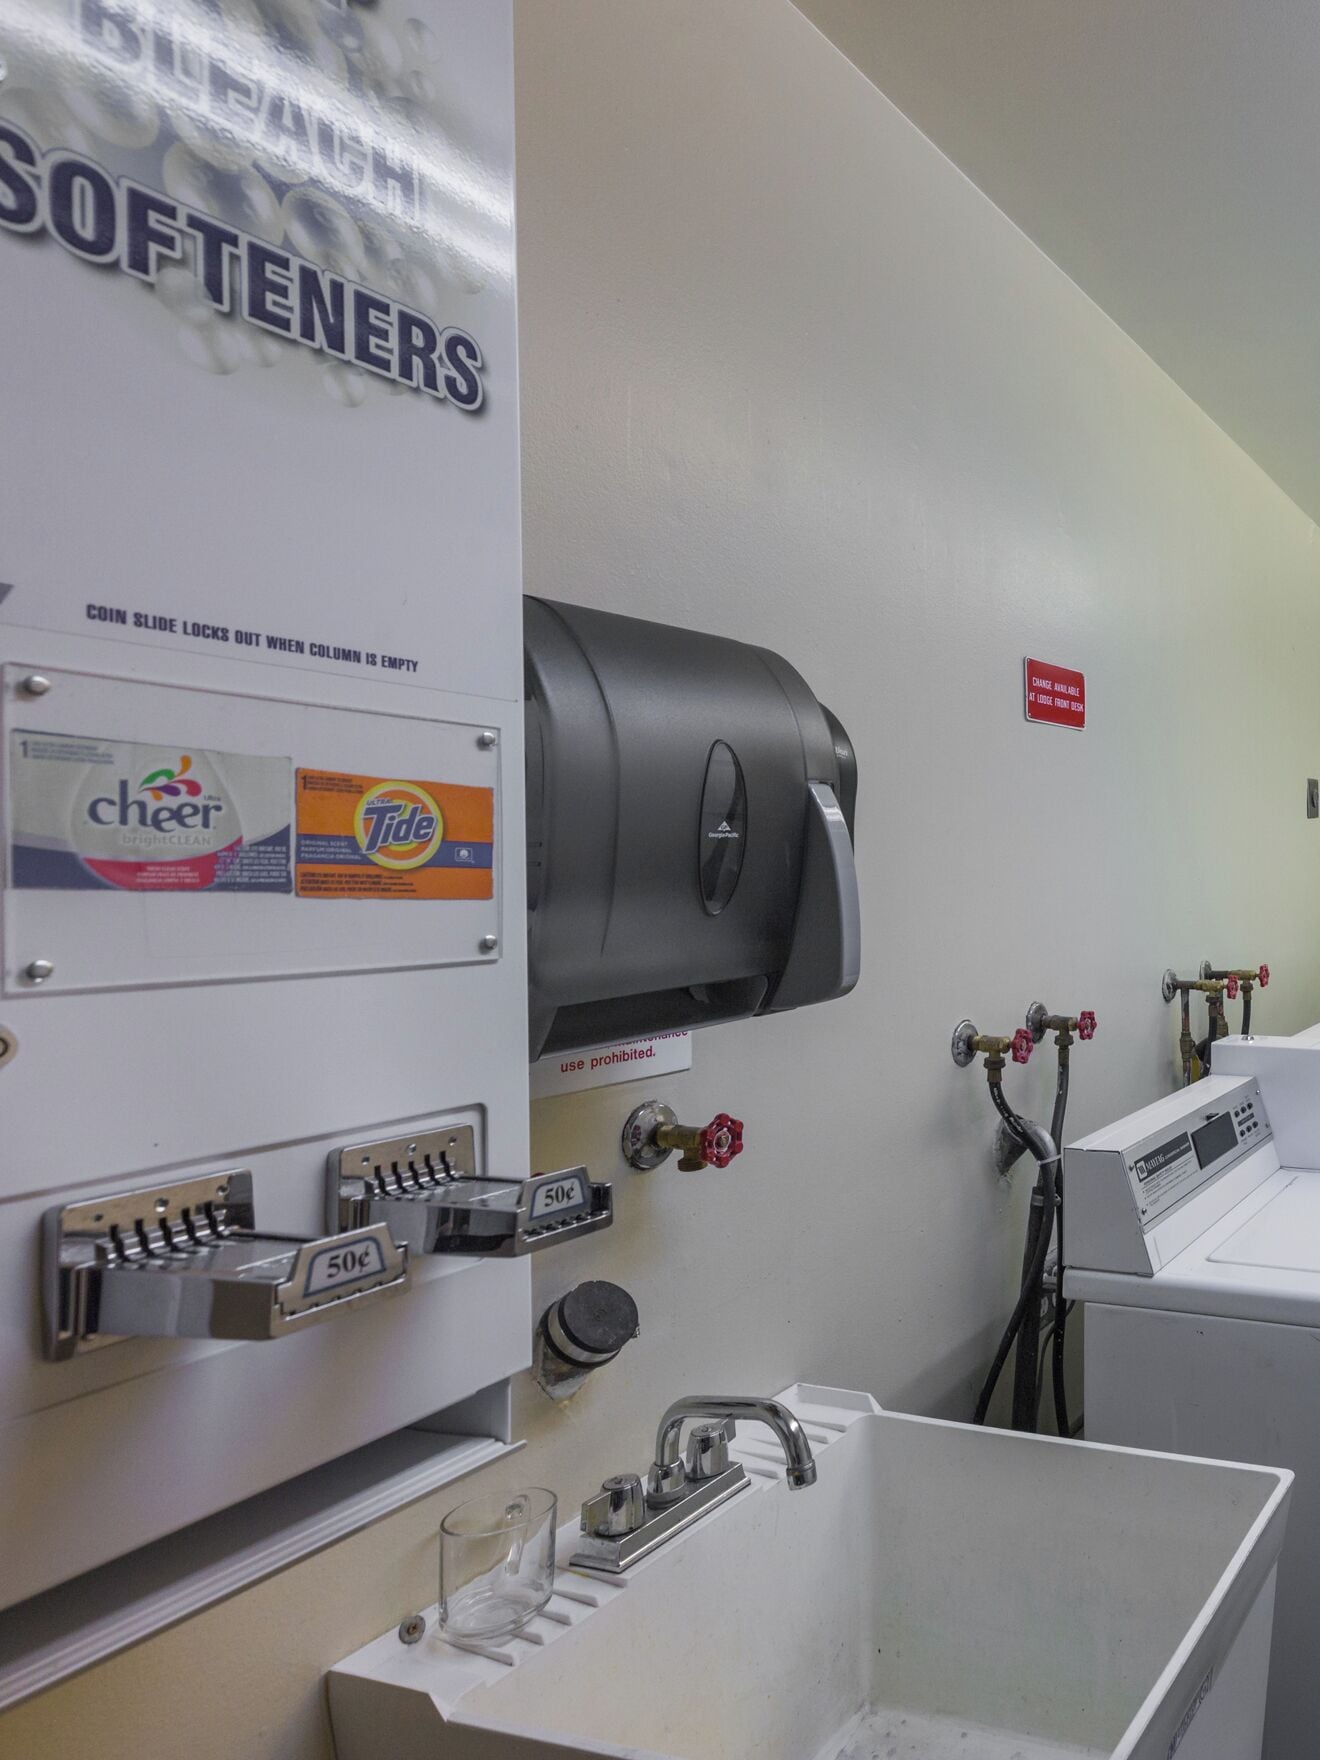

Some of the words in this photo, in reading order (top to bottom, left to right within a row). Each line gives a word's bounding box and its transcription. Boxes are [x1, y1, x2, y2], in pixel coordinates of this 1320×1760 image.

[86, 603, 127, 625] COIN
[133, 611, 178, 633] SLIDE
[182, 620, 230, 642] LOCKS
[234, 629, 262, 647] OUT
[265, 635, 305, 654] WHEN
[309, 642, 362, 663] COLUMN
[365, 652, 378, 666] IS
[381, 655, 419, 673] EMPTY
[1032, 676, 1052, 690] CHANGE
[1054, 682, 1080, 697] AVAILABLE
[1029, 692, 1035, 701] AT
[1037, 694, 1053, 706] LODGE
[1054, 697, 1070, 709] FRONT
[1071, 701, 1084, 712] DESK
[87, 778, 223, 833] cheer
[122, 834, 211, 847] brightCLEAN
[363, 803, 437, 854] Tide
[560, 1059, 585, 1073] use
[590, 1045, 656, 1070] prohibited.
[544, 1181, 576, 1208] 50¢
[326, 1244, 370, 1279] 50¢
